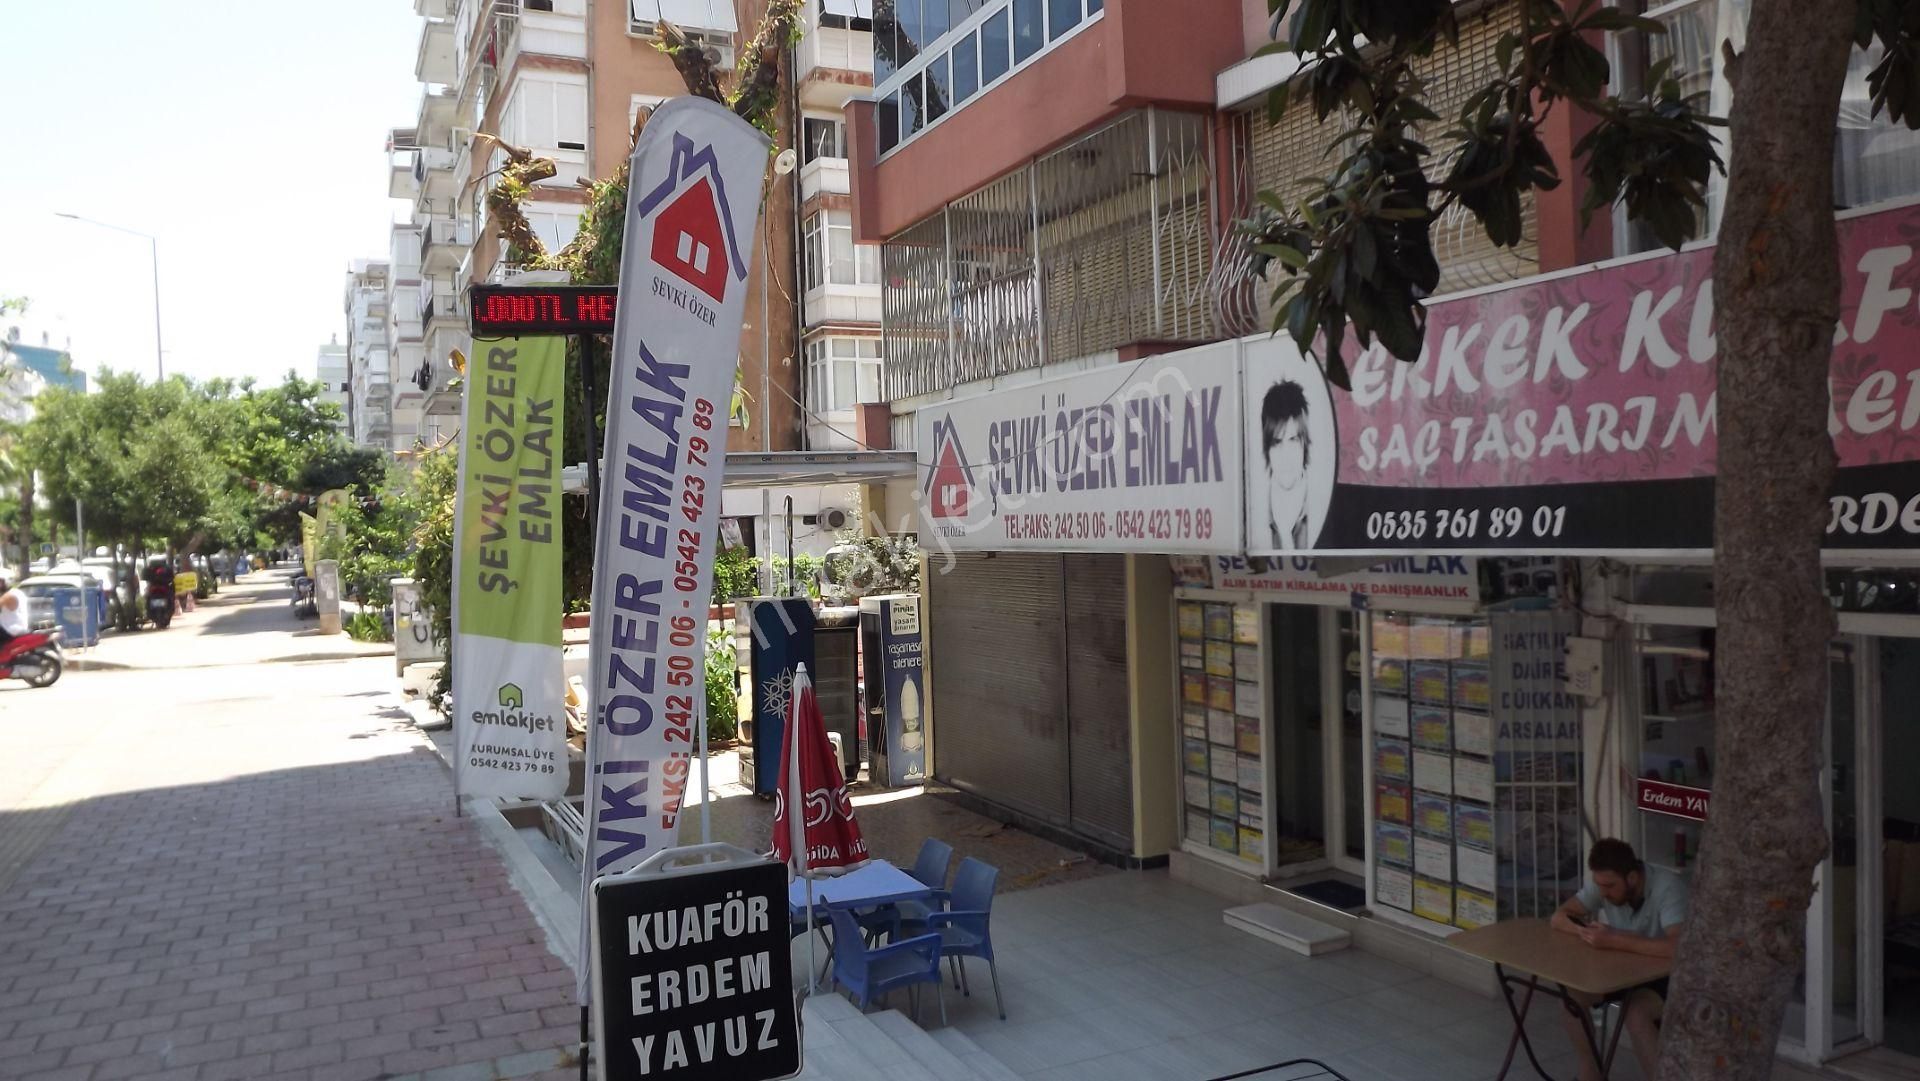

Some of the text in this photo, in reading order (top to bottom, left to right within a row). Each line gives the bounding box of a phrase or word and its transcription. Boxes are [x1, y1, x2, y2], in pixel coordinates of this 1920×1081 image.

[577, 295, 617, 322] HE
[652, 276, 716, 328] ŞEVKİ ÖZER
[692, 399, 714, 431] 89
[475, 346, 518, 595] ŞEVKİ ÖZER
[517, 397, 553, 543] EMLAK
[620, 339, 690, 559] EMLAK
[688, 436, 709, 467] 79
[988, 385, 1223, 517] ŞEVKİ ÖZER EMLAK
[1357, 420, 1441, 476] SAÇ
[682, 475, 706, 523] 423
[1004, 513, 1052, 539] TEL-FAKS:
[1055, 512, 1075, 539] 242
[1076, 512, 1089, 538] 50
[1092, 511, 1106, 538] 06
[1116, 510, 1145, 539] 0542
[1149, 509, 1172, 539] 423
[1175, 508, 1192, 538] 79
[1196, 507, 1213, 539] 89
[1367, 506, 1566, 540] 0535 761 89 01
[673, 529, 701, 592] 0542
[1222, 578, 1469, 597] ALIM SATIM KİRALAMA VE DANIŞMANLIK
[598, 573, 663, 736] ÖZER
[669, 616, 695, 647] 06
[667, 655, 694, 687] 50
[472, 707, 554, 734] emlakjet
[664, 694, 692, 743] 242
[470, 744, 555, 761] KURUMSAL ÜYE
[470, 758, 555, 774] 0542 423 79 89
[1643, 788, 1682, 807] Erdem
[627, 890, 768, 955] KUAFÖR
[631, 951, 771, 1016] ERDEM
[632, 1009, 778, 1075] YAVUZ
